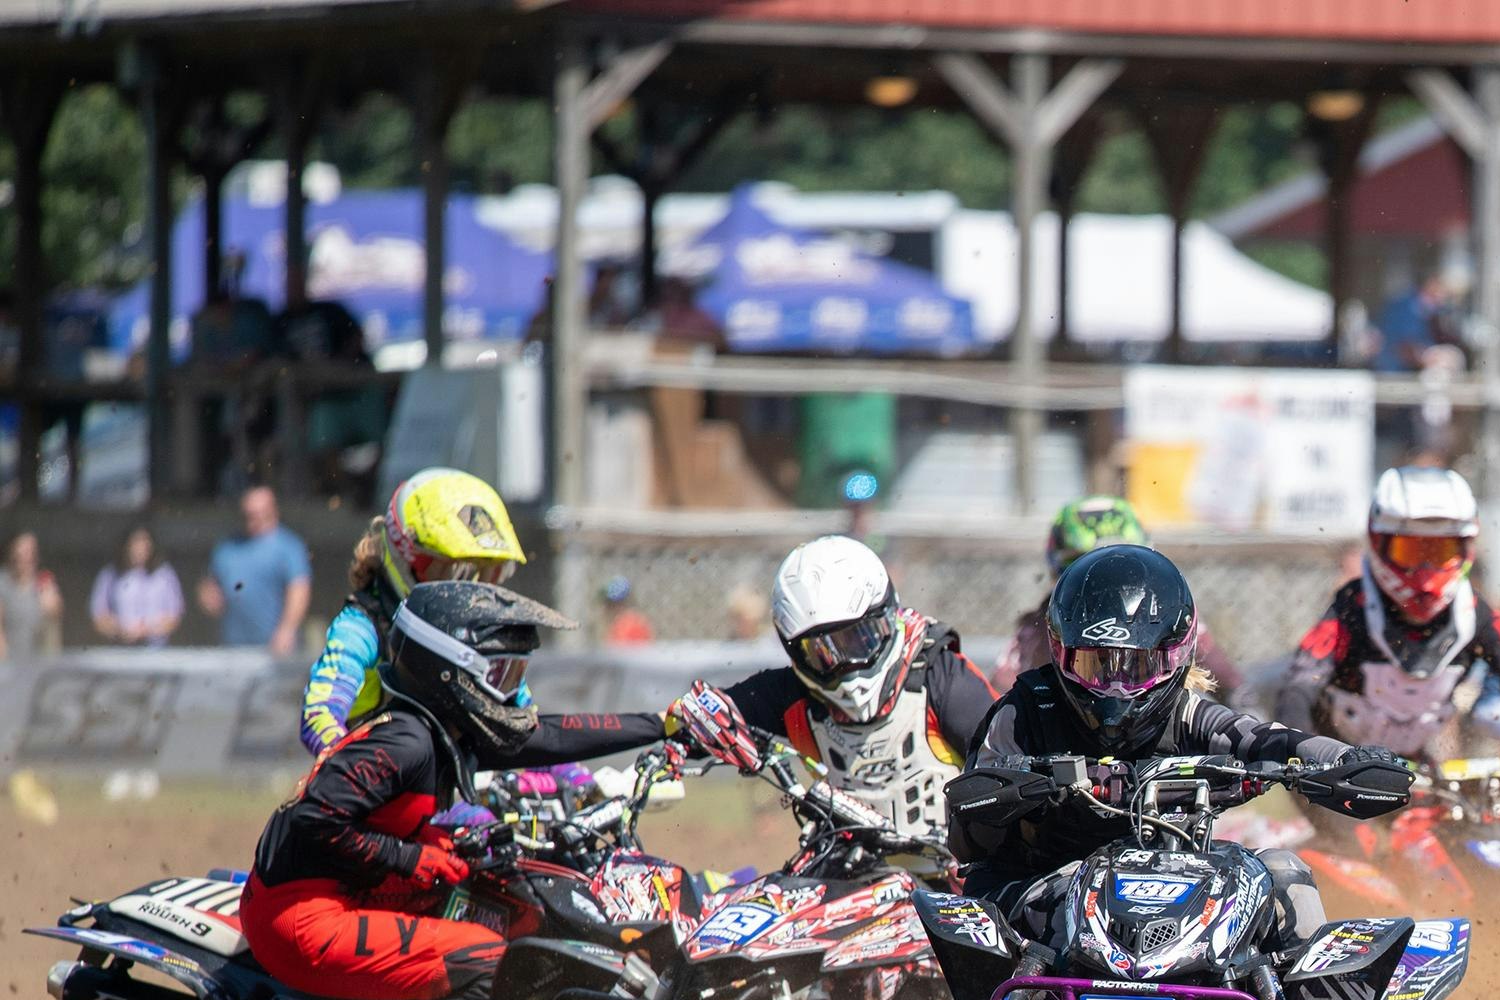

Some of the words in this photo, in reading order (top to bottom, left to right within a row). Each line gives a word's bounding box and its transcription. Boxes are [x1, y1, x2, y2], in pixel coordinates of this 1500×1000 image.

[1082, 618, 1130, 640] 6D
[1119, 880, 1189, 898] 130
[706, 904, 773, 938] 53
